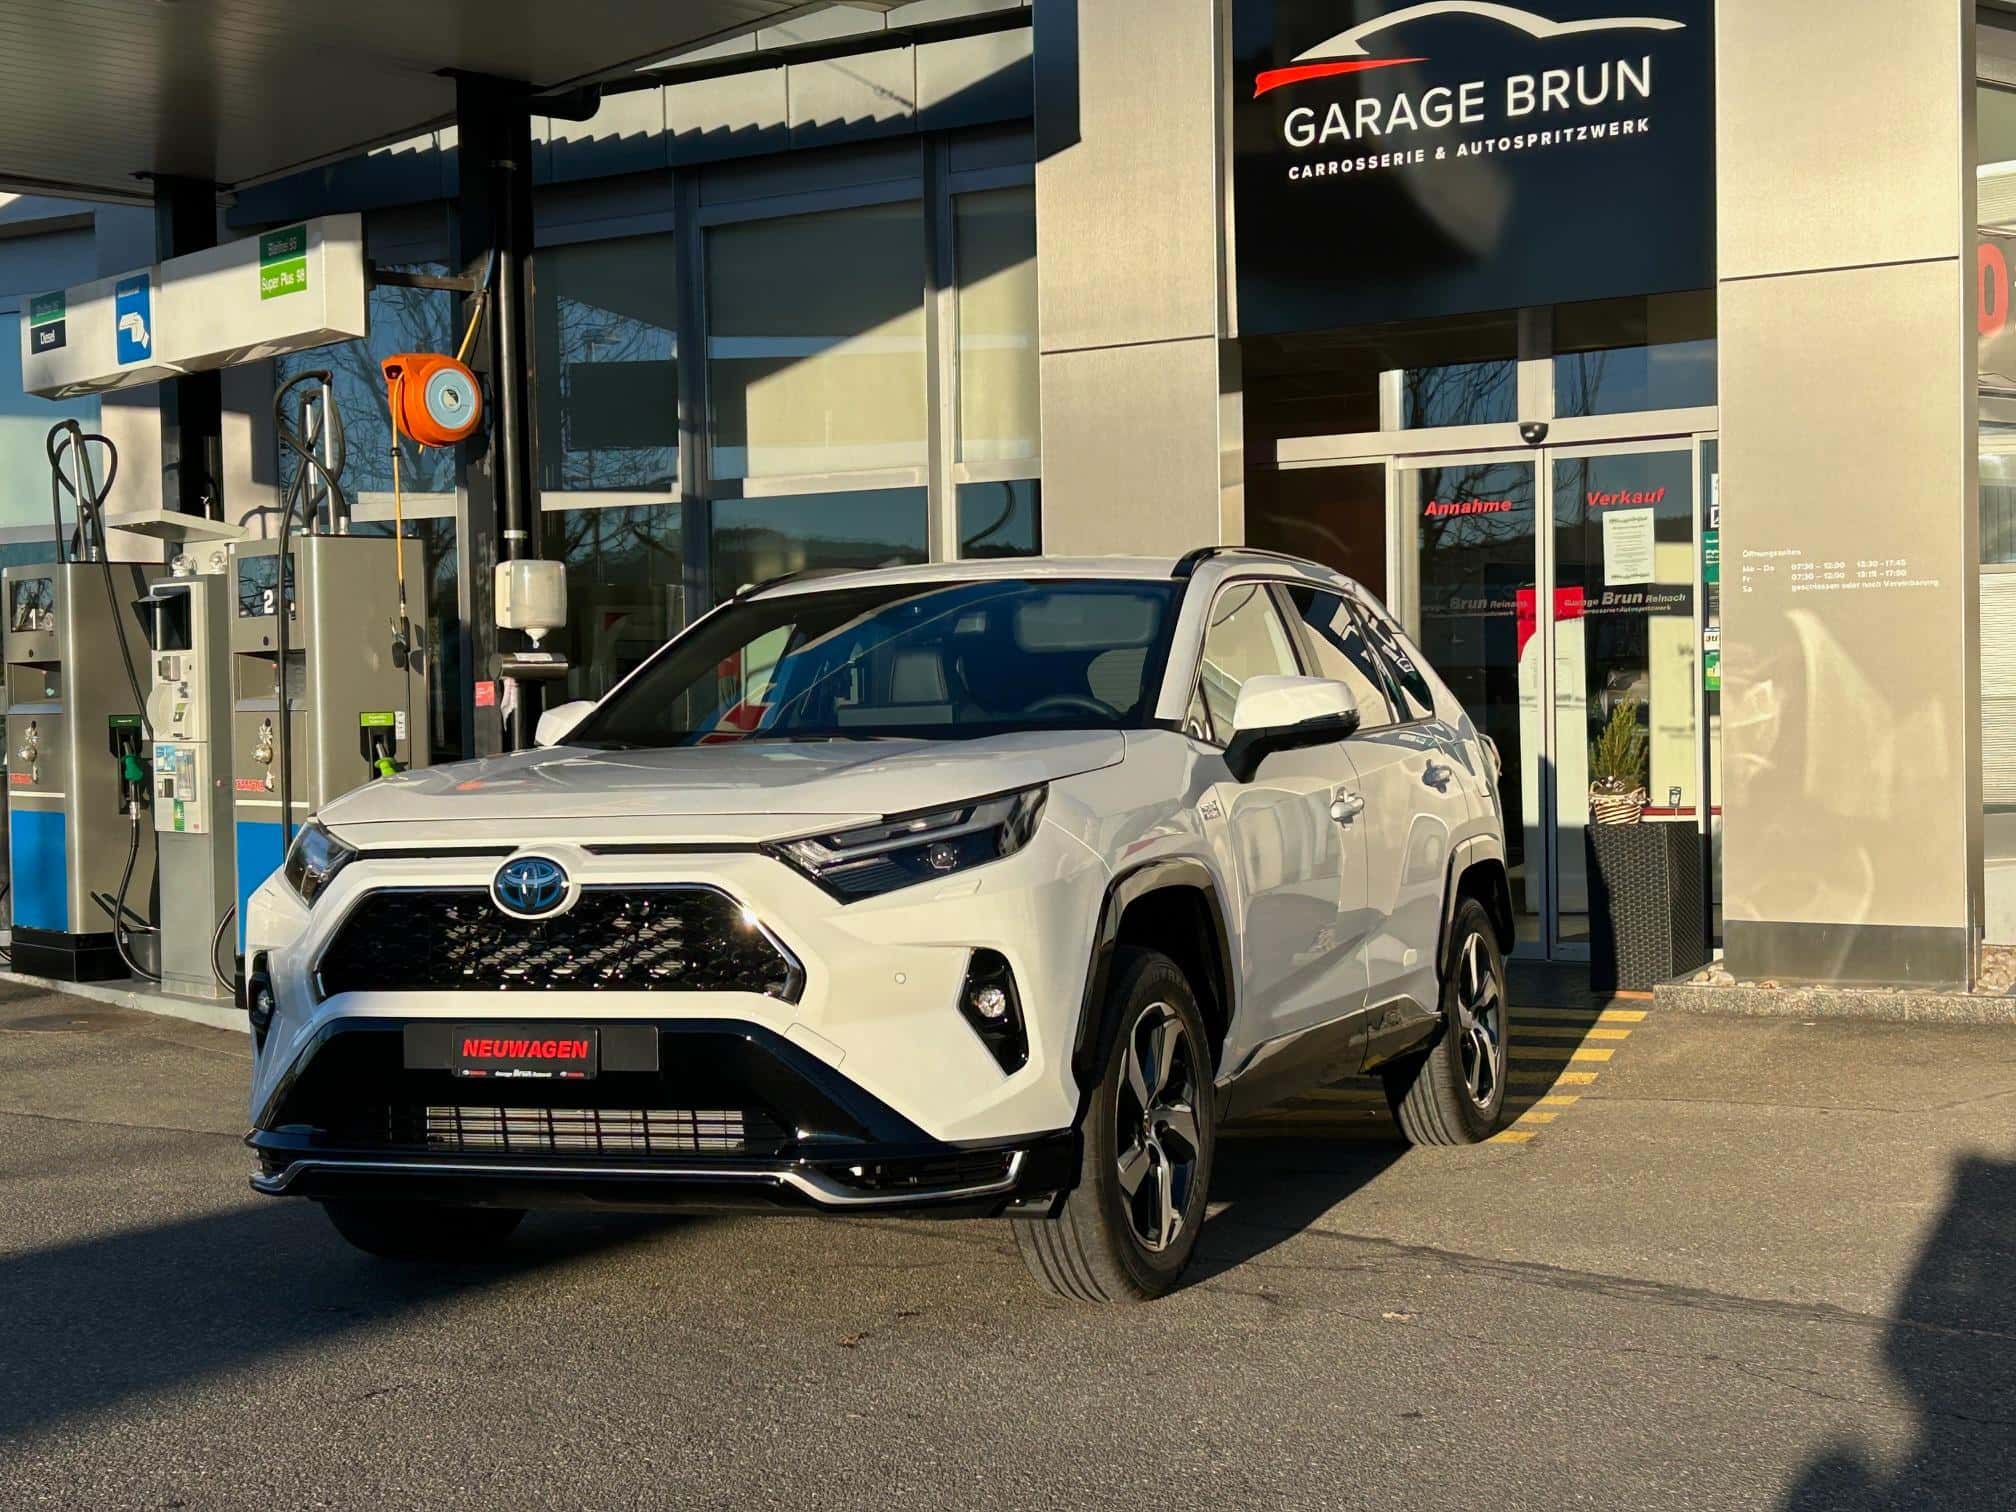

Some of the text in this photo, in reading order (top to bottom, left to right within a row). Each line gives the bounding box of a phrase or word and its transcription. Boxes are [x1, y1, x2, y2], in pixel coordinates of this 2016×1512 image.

[1284, 55, 1651, 147] GARAGE BRUN
[1288, 118, 1649, 180] CARROSSERIE & AUTOSPRITZWERK
[40, 328, 56, 345] Diesel
[1587, 488, 1666, 506] Verkauf
[1424, 498, 1513, 516] Annahme
[263, 589, 273, 614] 2
[1601, 591, 1642, 605] Brun
[1645, 592, 1686, 604] Reinach
[462, 1039, 588, 1058] NEUWAGEN
